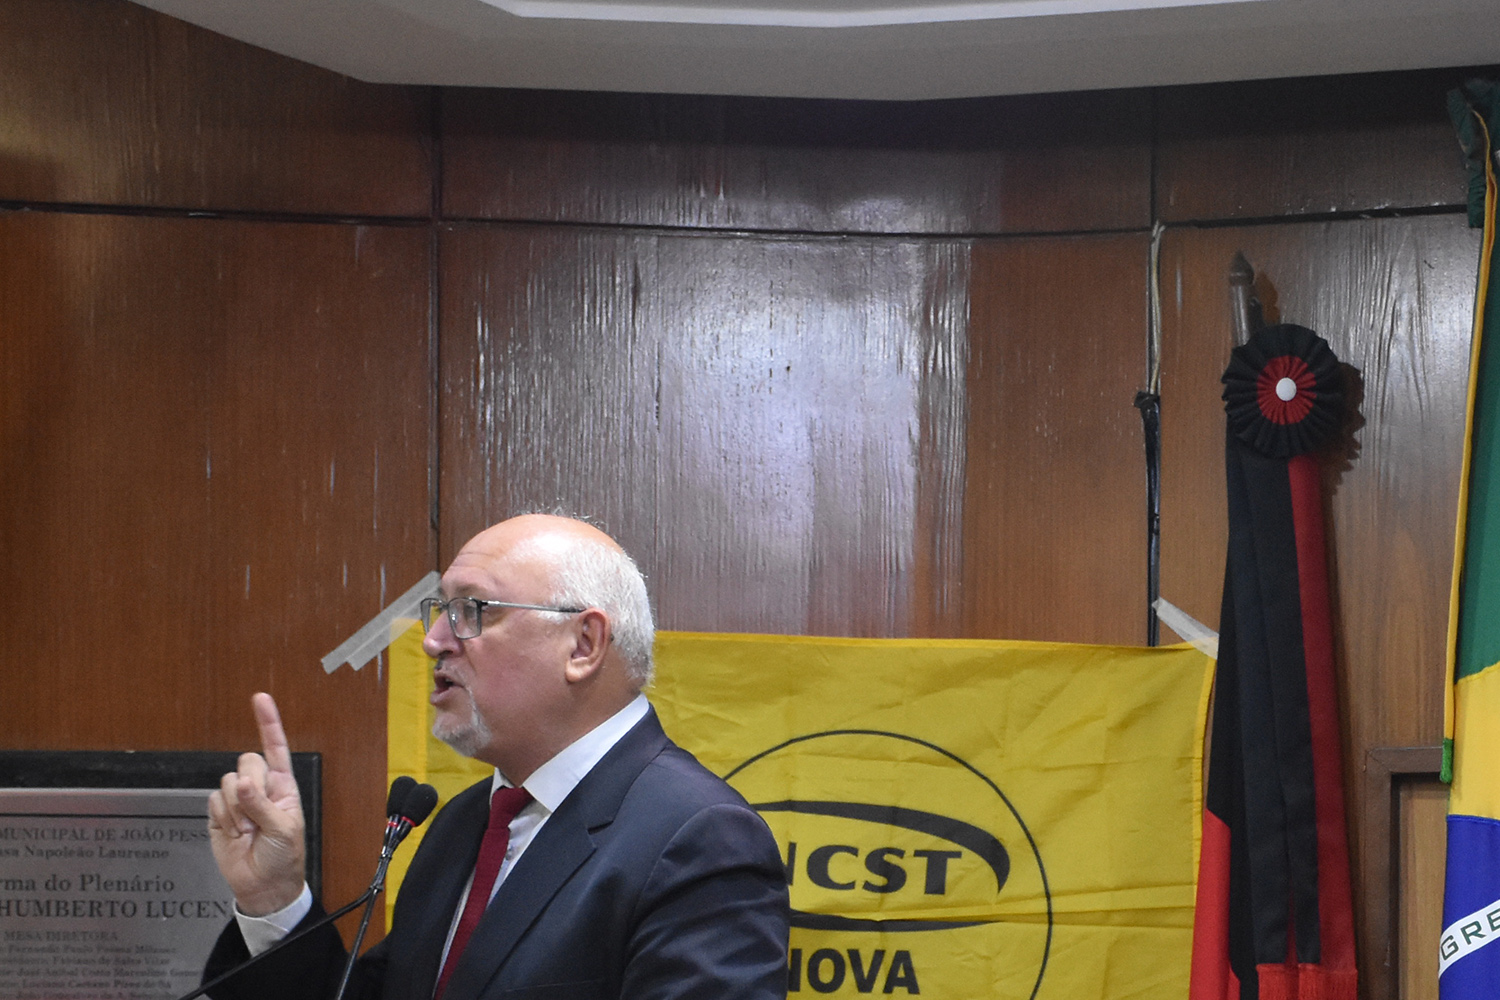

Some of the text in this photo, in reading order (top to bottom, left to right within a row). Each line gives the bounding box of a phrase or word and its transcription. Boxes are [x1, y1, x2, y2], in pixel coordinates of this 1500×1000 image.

[94, 828, 116, 841] DE
[169, 828, 209, 842] PESS
[44, 873, 72, 892] do
[79, 873, 175, 893] Plenário
[0, 899, 236, 919] HUMBERTO LUCEN
